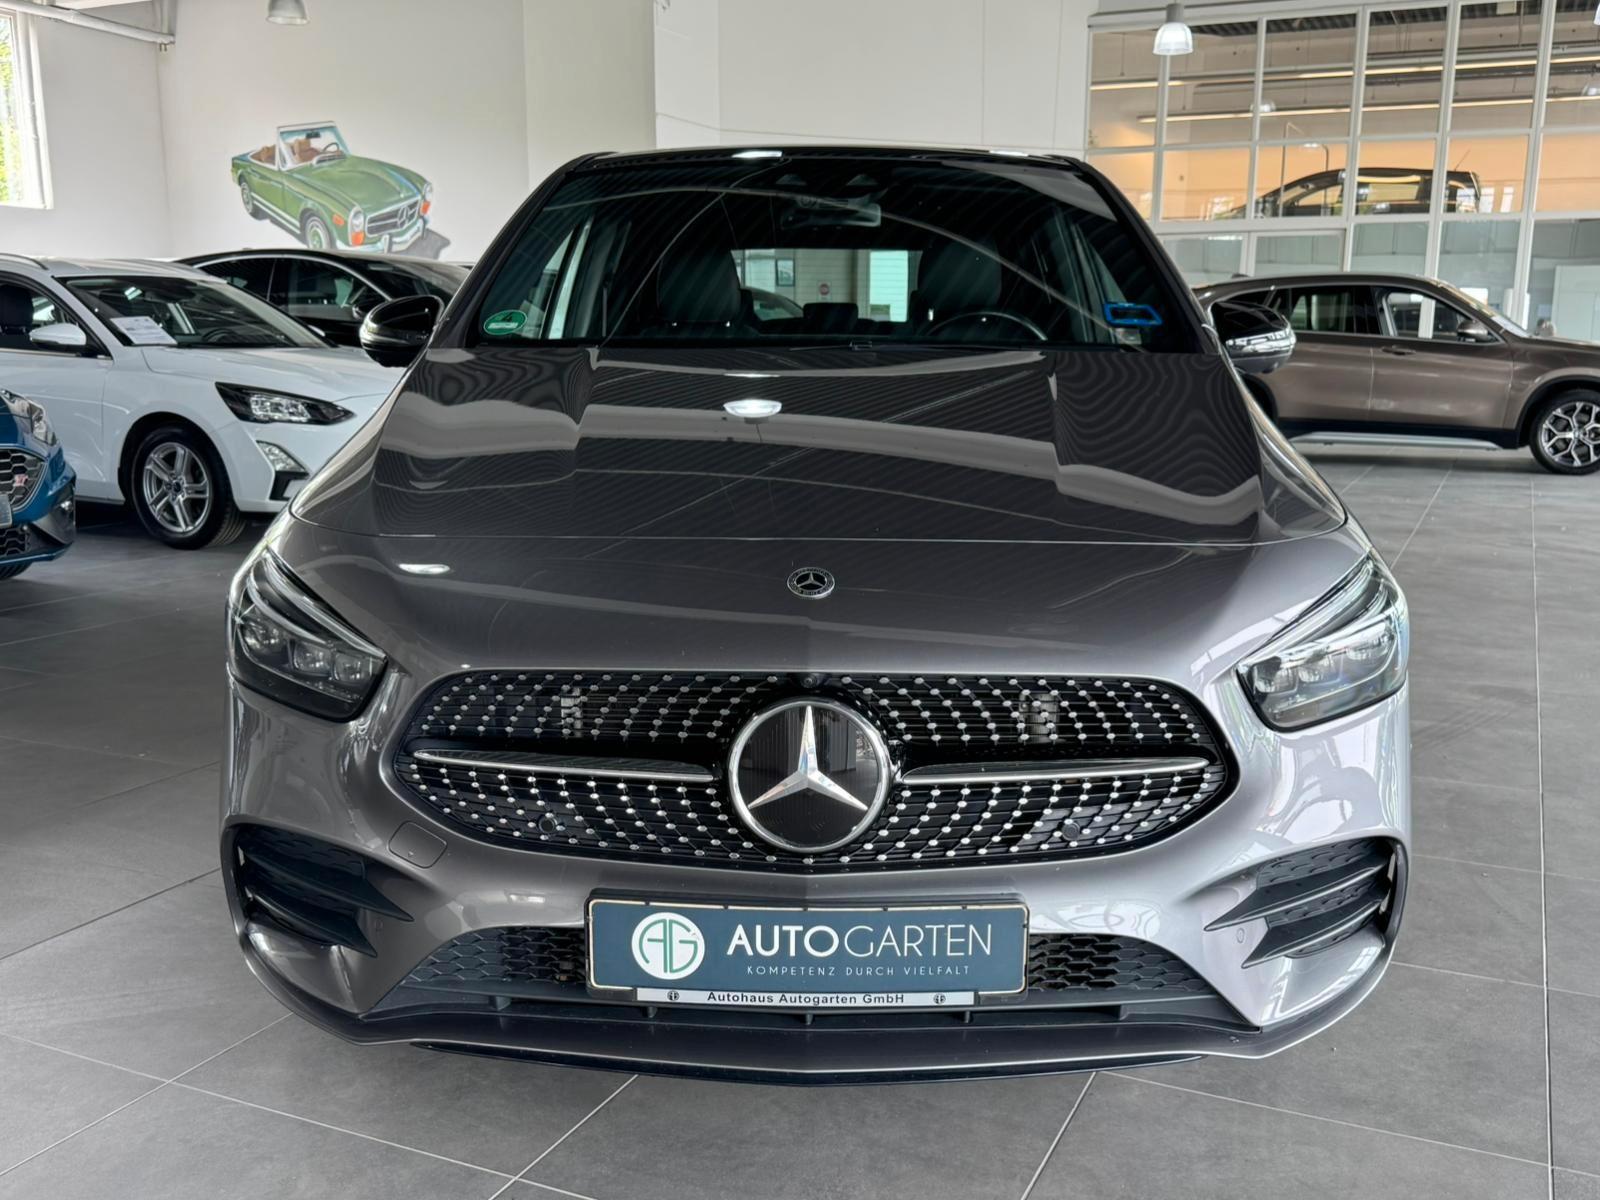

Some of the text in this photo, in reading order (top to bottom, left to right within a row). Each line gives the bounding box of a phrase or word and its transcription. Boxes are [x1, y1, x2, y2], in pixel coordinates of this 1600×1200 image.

[727, 923, 992, 957] AUTOGARTEN
[747, 965, 970, 976] KOMPETENZ DURCH VIELFALT
[707, 991, 905, 1006] Autohaus Autogarten GmbH
